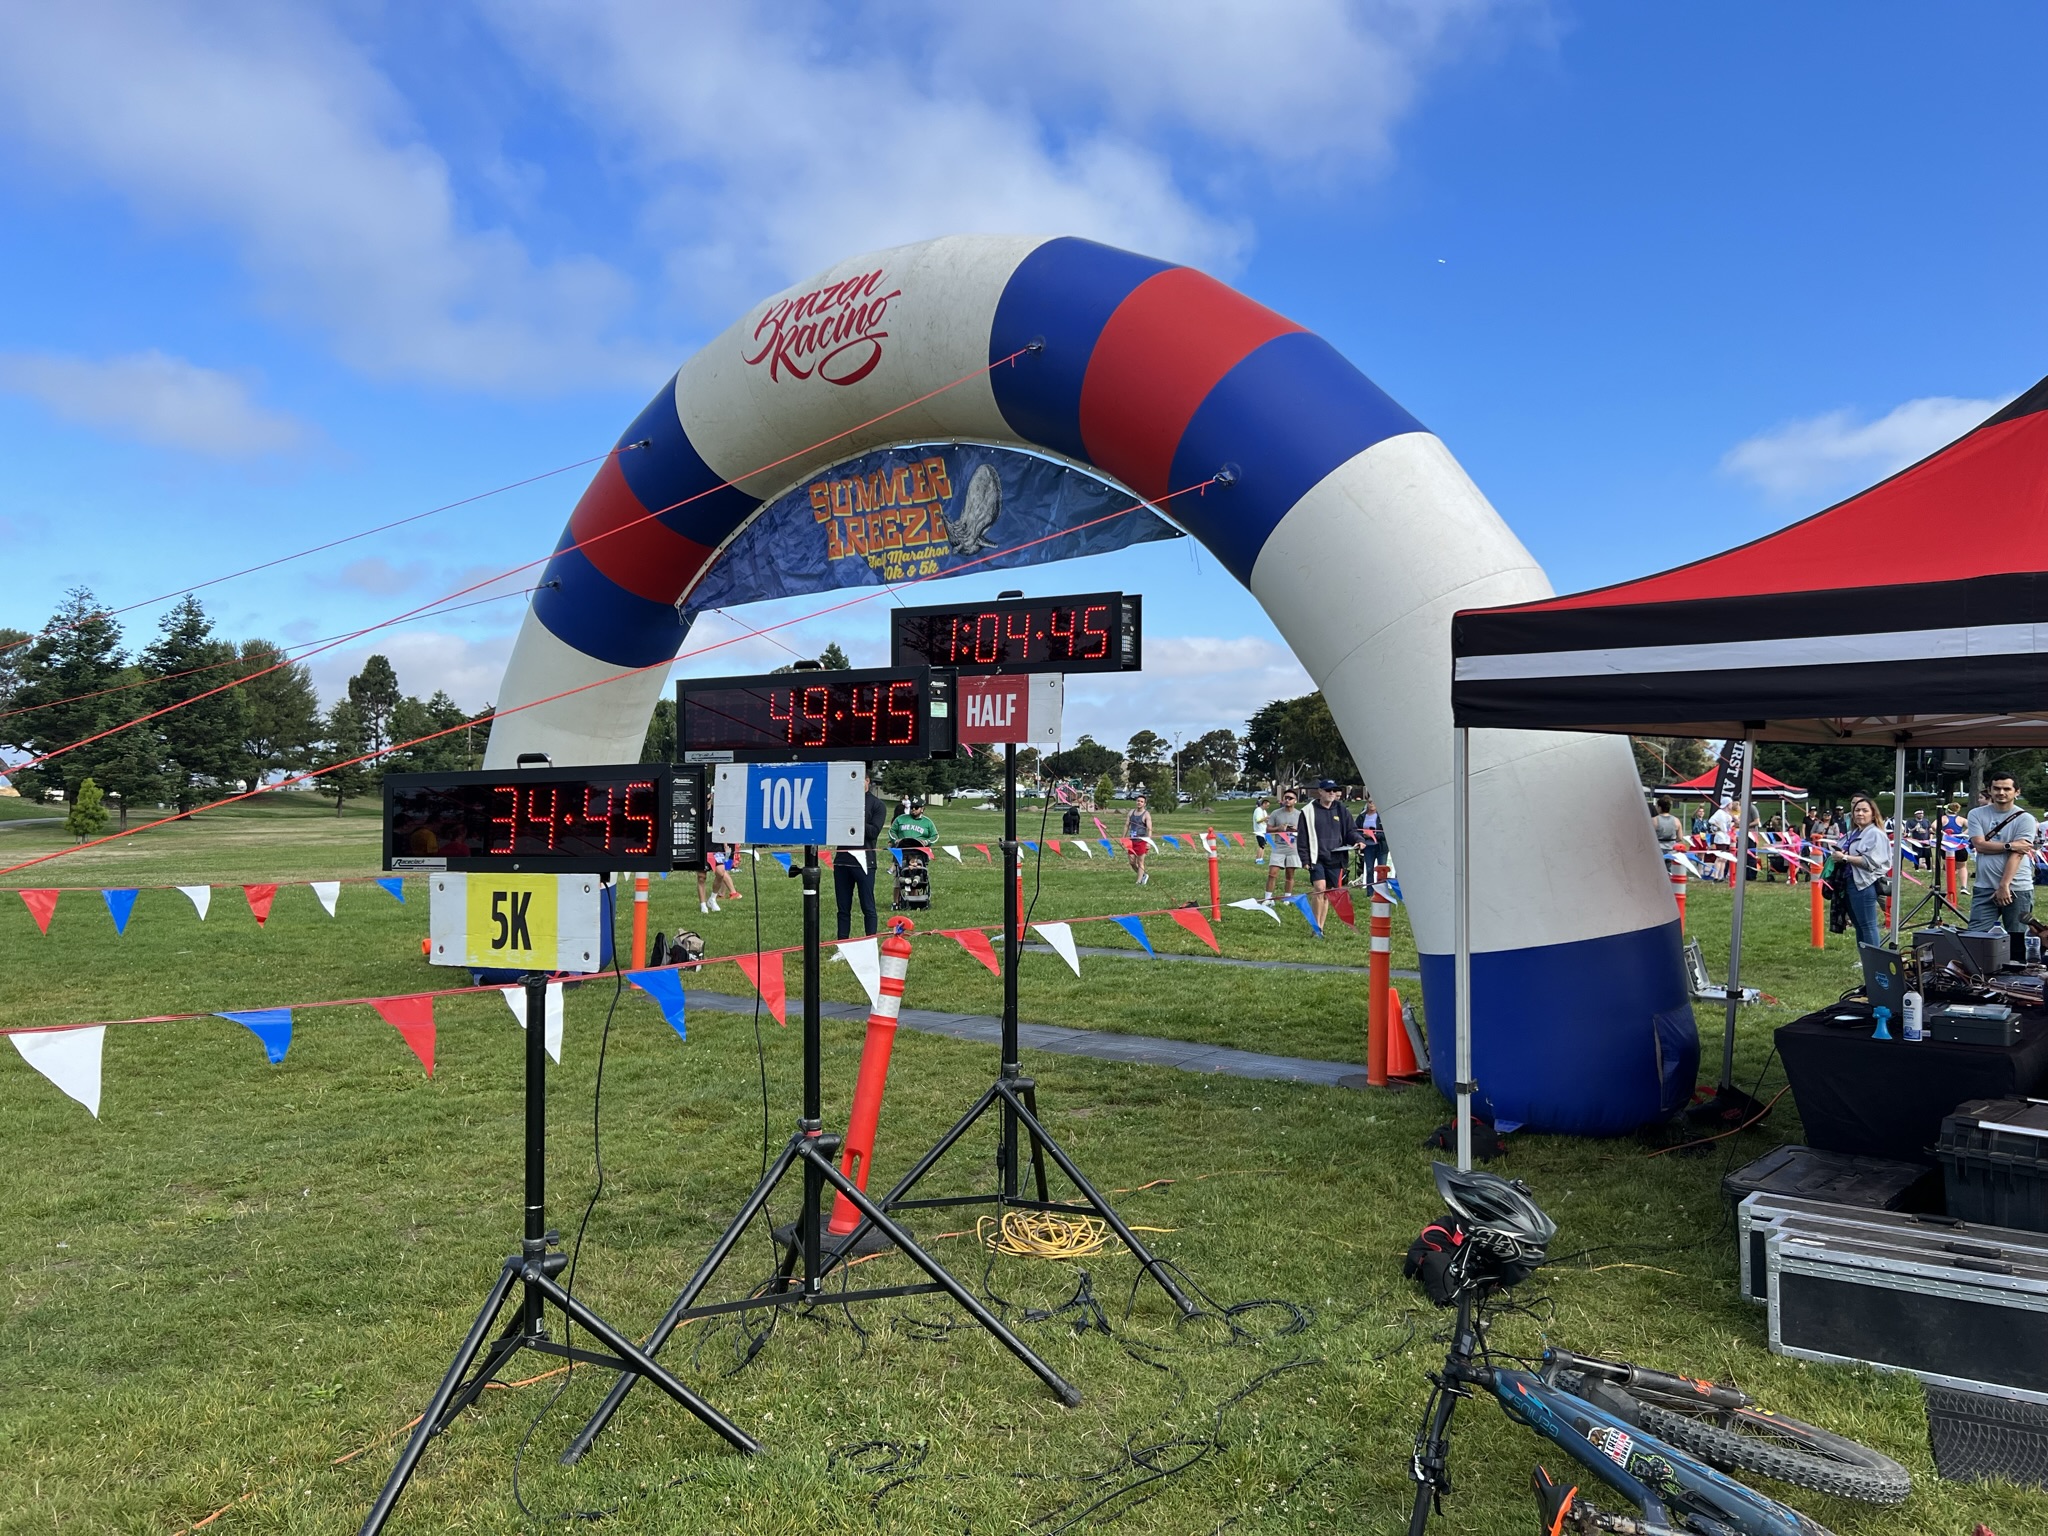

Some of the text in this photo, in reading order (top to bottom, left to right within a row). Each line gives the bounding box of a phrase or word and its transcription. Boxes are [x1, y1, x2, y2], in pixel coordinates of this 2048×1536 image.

[741, 268, 891, 366] Brazen
[769, 289, 902, 386] Racing
[808, 456, 953, 524] SUMMER
[825, 501, 949, 561] BREEZE
[886, 545, 950, 566] Marathon
[906, 564, 917, 578] &
[919, 559, 939, 576] 5k
[965, 693, 1017, 728] HALF
[760, 777, 814, 830] 10K
[1720, 777, 1737, 800] AI
[901, 824, 925, 835] MEXICO
[491, 891, 533, 951] 5K
